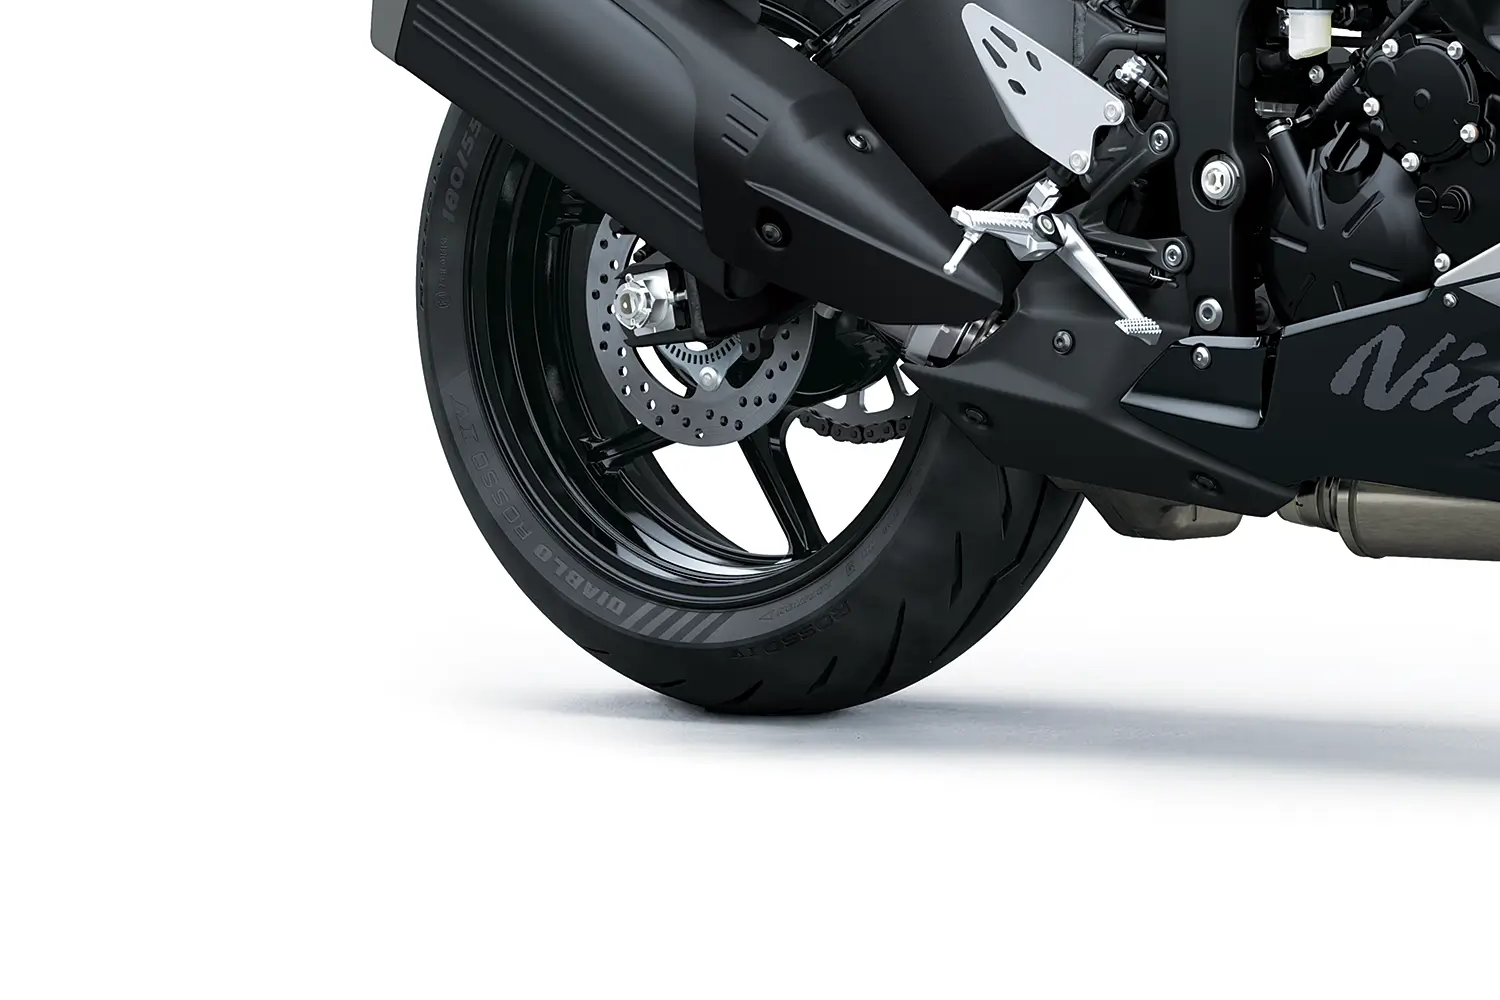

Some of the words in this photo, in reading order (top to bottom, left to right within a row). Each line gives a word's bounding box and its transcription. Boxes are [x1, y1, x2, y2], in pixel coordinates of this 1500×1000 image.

[442, 116, 482, 224] 180/55
[449, 394, 480, 445] IV
[471, 451, 532, 541] ROSSO
[533, 542, 626, 616] DIABLO
[763, 599, 851, 656] ROSSO
